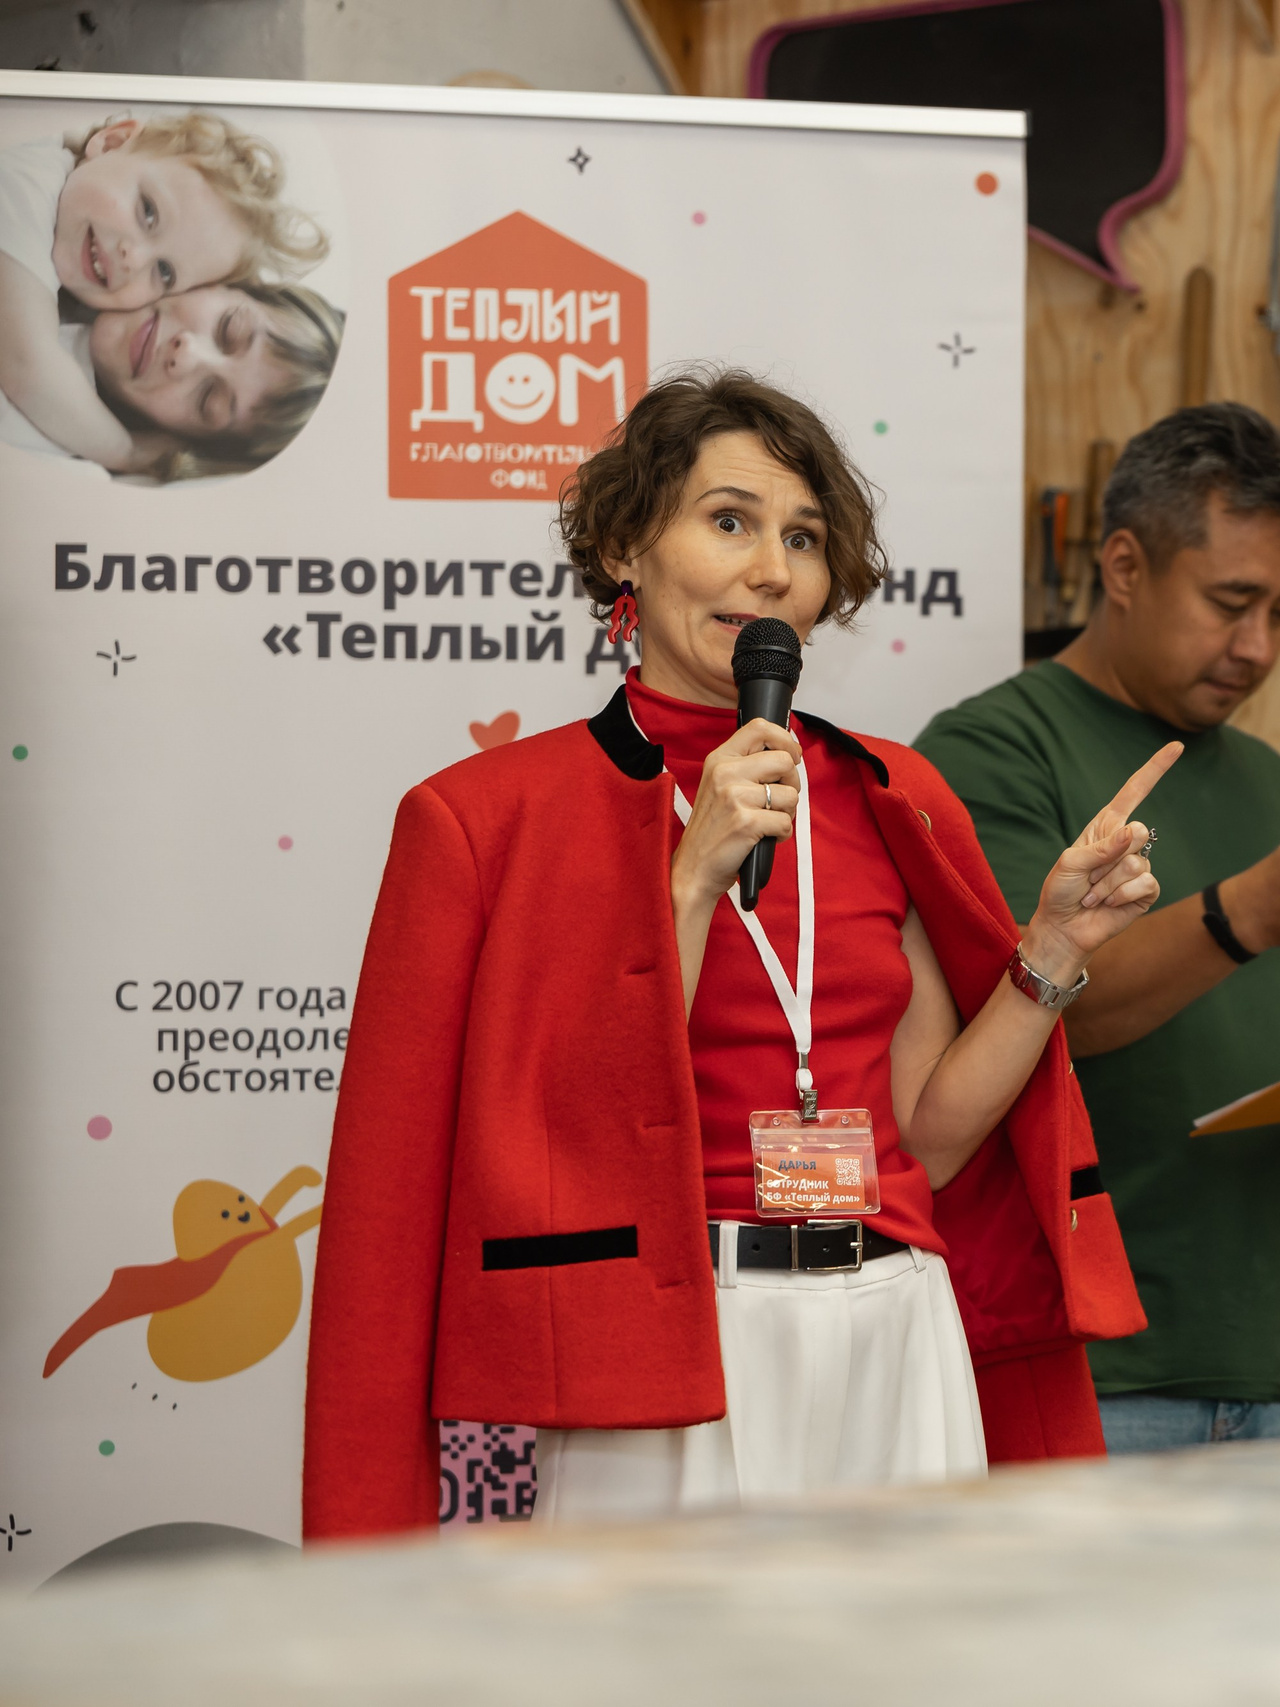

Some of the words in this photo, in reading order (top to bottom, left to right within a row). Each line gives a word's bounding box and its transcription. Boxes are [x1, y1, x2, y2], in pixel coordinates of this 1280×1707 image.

[410, 352, 627, 432] ДОМ
[490, 468, 548, 491] ФОНД
[54, 542, 585, 611] Благотворител
[868, 568, 964, 618] нд
[262, 610, 566, 662] «Теплый
[115, 979, 139, 1011] С
[152, 979, 244, 1011] 2007
[258, 986, 347, 1018] года
[157, 1027, 349, 1061] преодоле
[153, 1060, 339, 1092] обстояте
[778, 1159, 817, 1171] ДАРЬЯ
[832, 1195, 860, 1204] дом»
